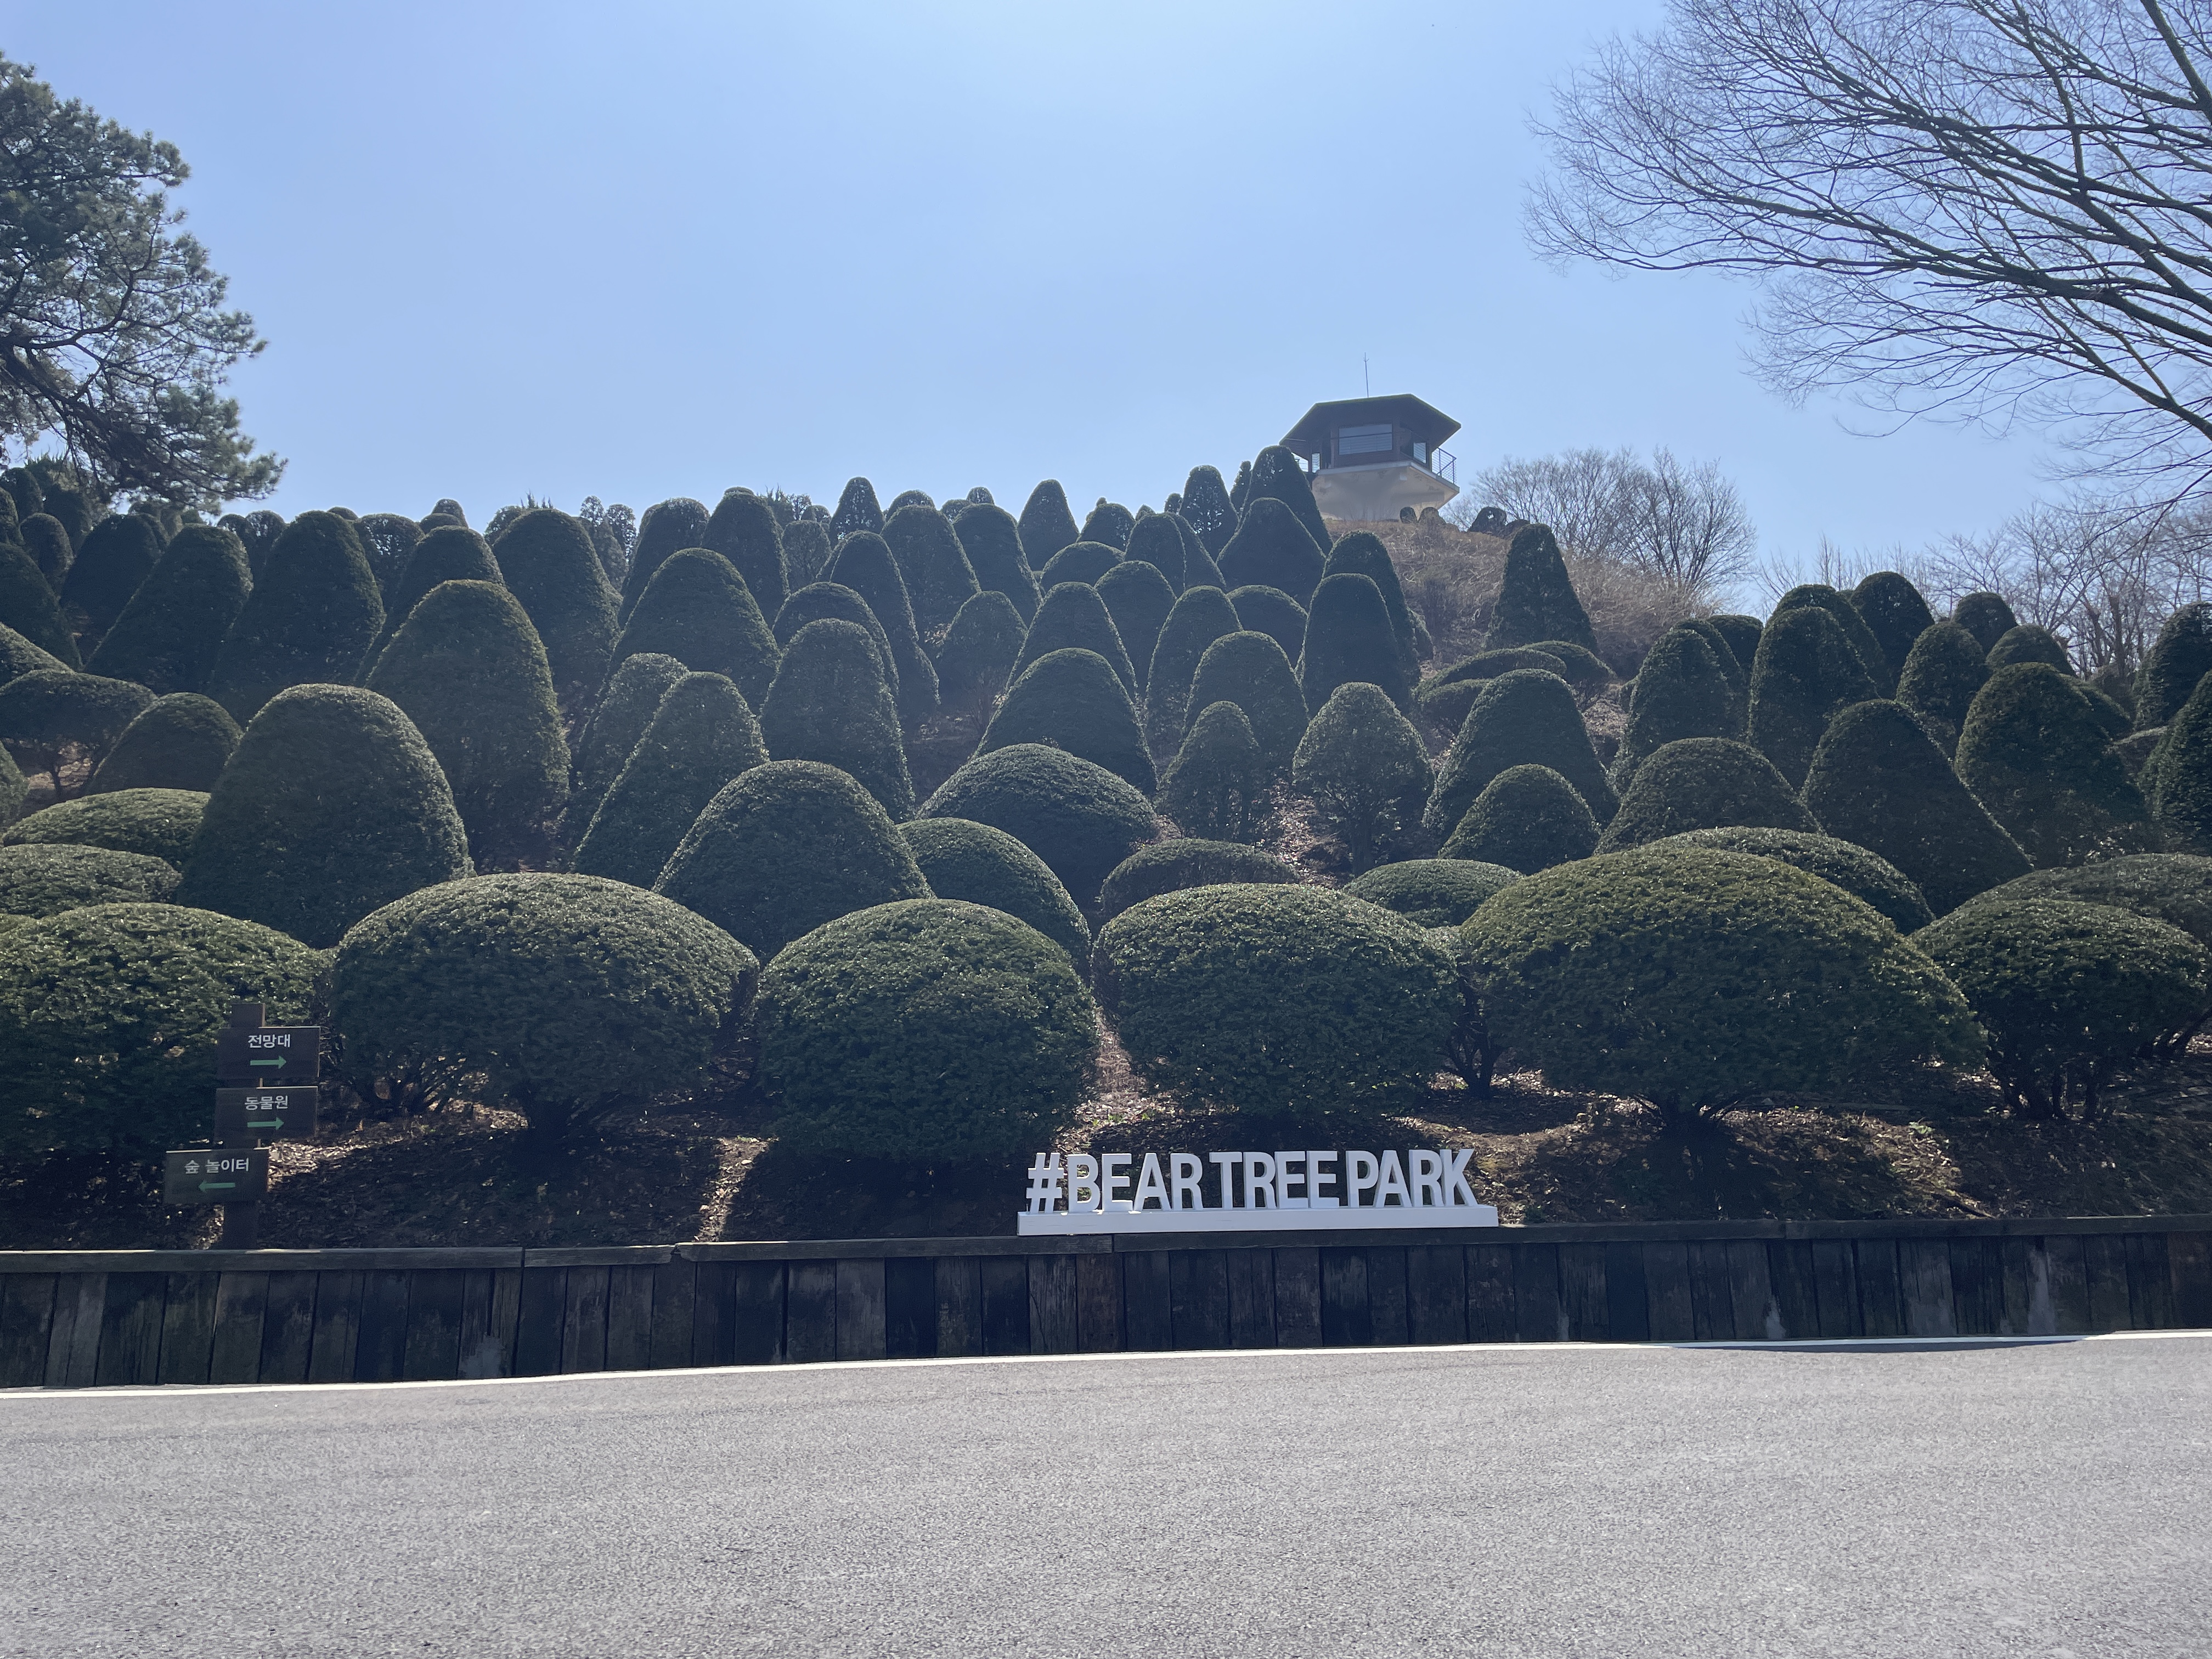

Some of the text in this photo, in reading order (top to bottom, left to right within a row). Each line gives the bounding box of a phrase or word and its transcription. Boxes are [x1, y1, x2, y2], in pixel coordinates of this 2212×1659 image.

[247, 1034, 291, 1048] 전망대
[245, 1095, 288, 1110] 동물원
[184, 1158, 249, 1174] 숲 놀이터
[1025, 1148, 1480, 1214] #BEAR TREE PARK
